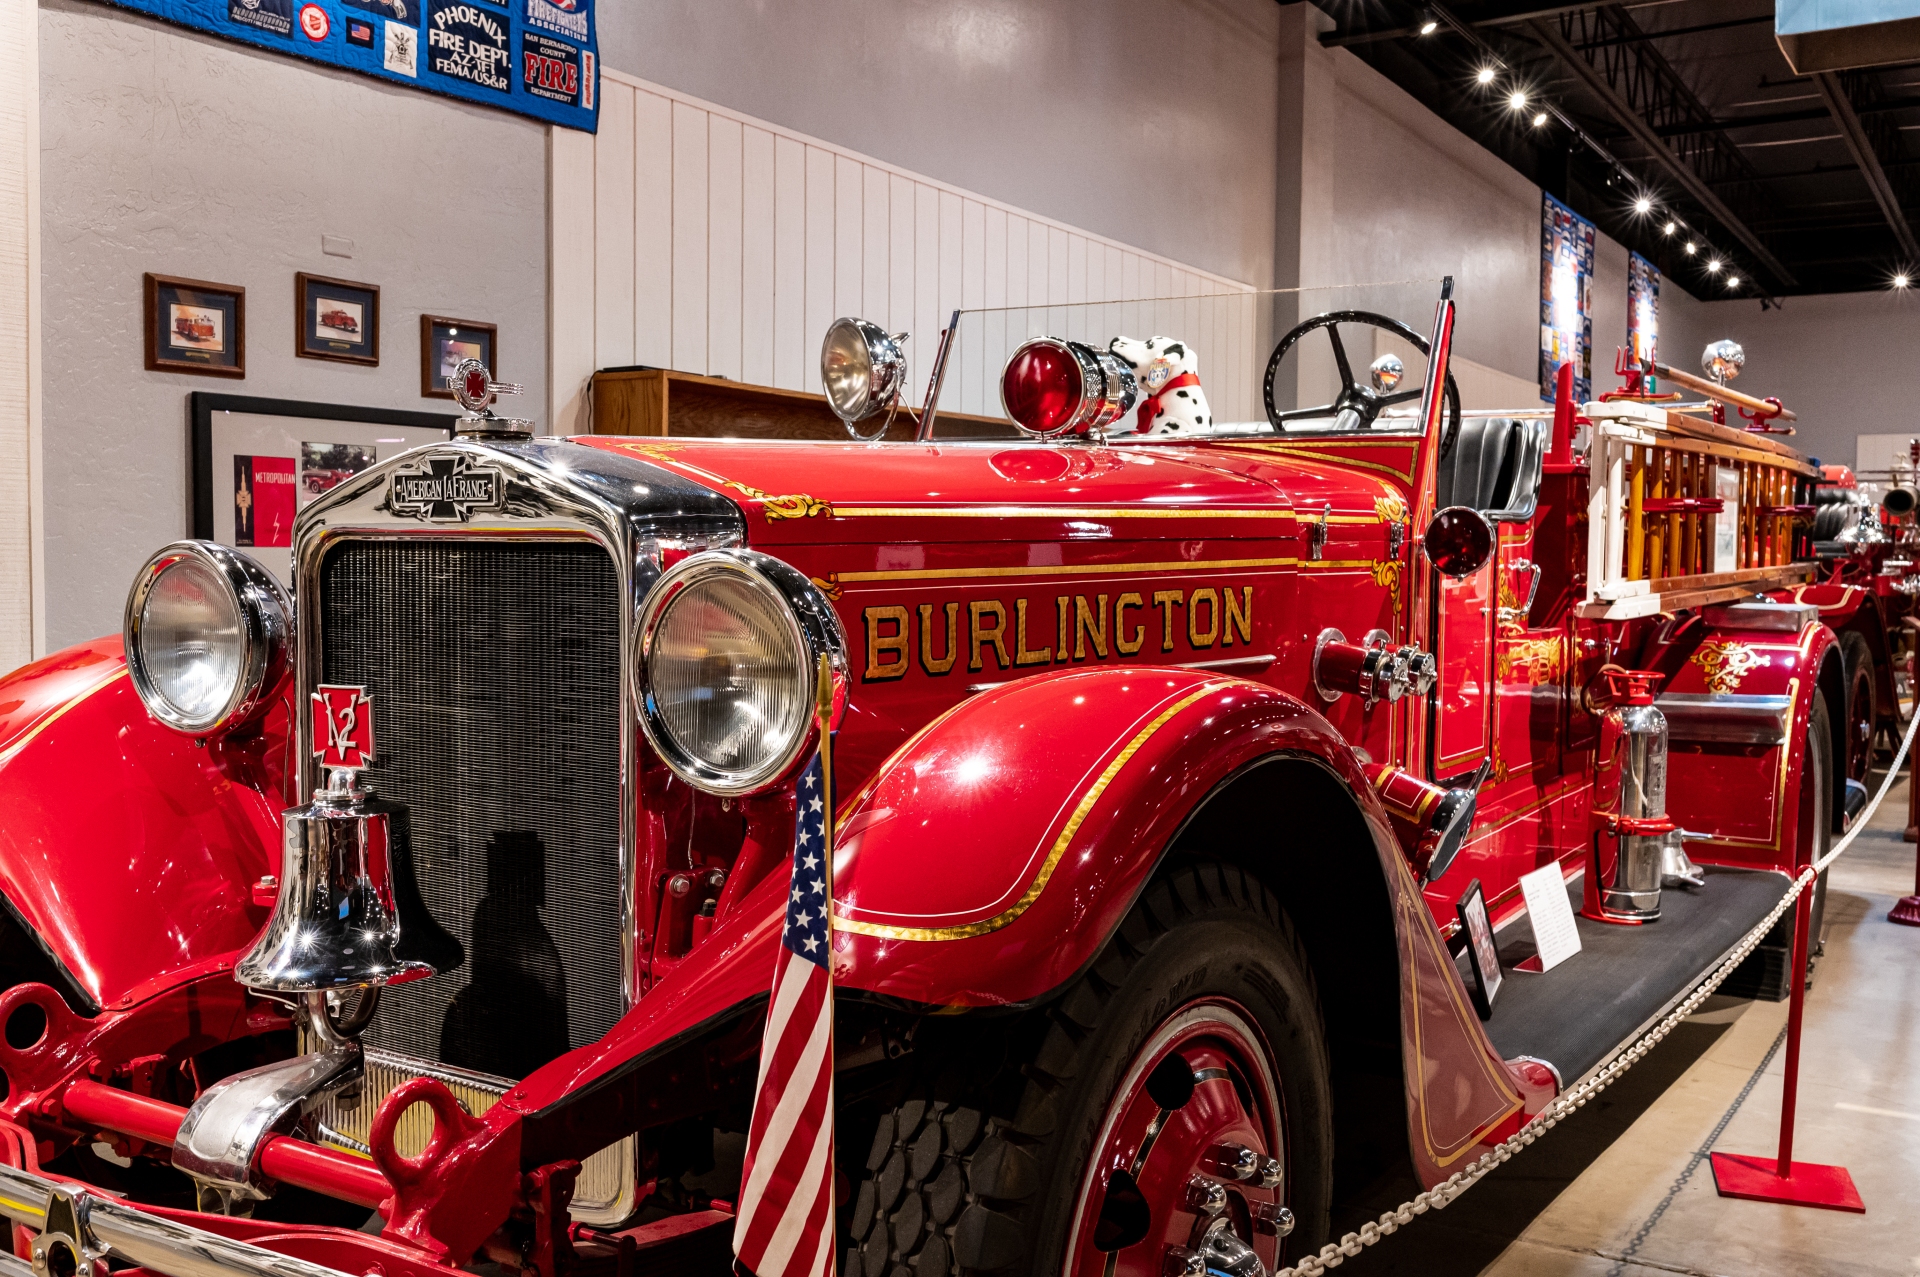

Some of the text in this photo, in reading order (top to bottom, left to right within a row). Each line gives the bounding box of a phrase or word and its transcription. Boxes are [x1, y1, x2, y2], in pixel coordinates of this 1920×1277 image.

[433, 6, 507, 48] PHOENIX
[526, 0, 588, 35] FIREFIGHTERS
[528, 17, 588, 43] ASSOCIATION
[429, 28, 512, 68] FIRE DEPT.
[524, 33, 539, 43] SAN
[540, 46, 566, 59] COUNTY
[524, 51, 578, 95] FIRE
[531, 86, 572, 103] DEPARTMENT
[255, 472, 296, 485] METROPOLITAN
[400, 476, 443, 502] AMERICAN
[861, 585, 1253, 684] BURLINGTON
